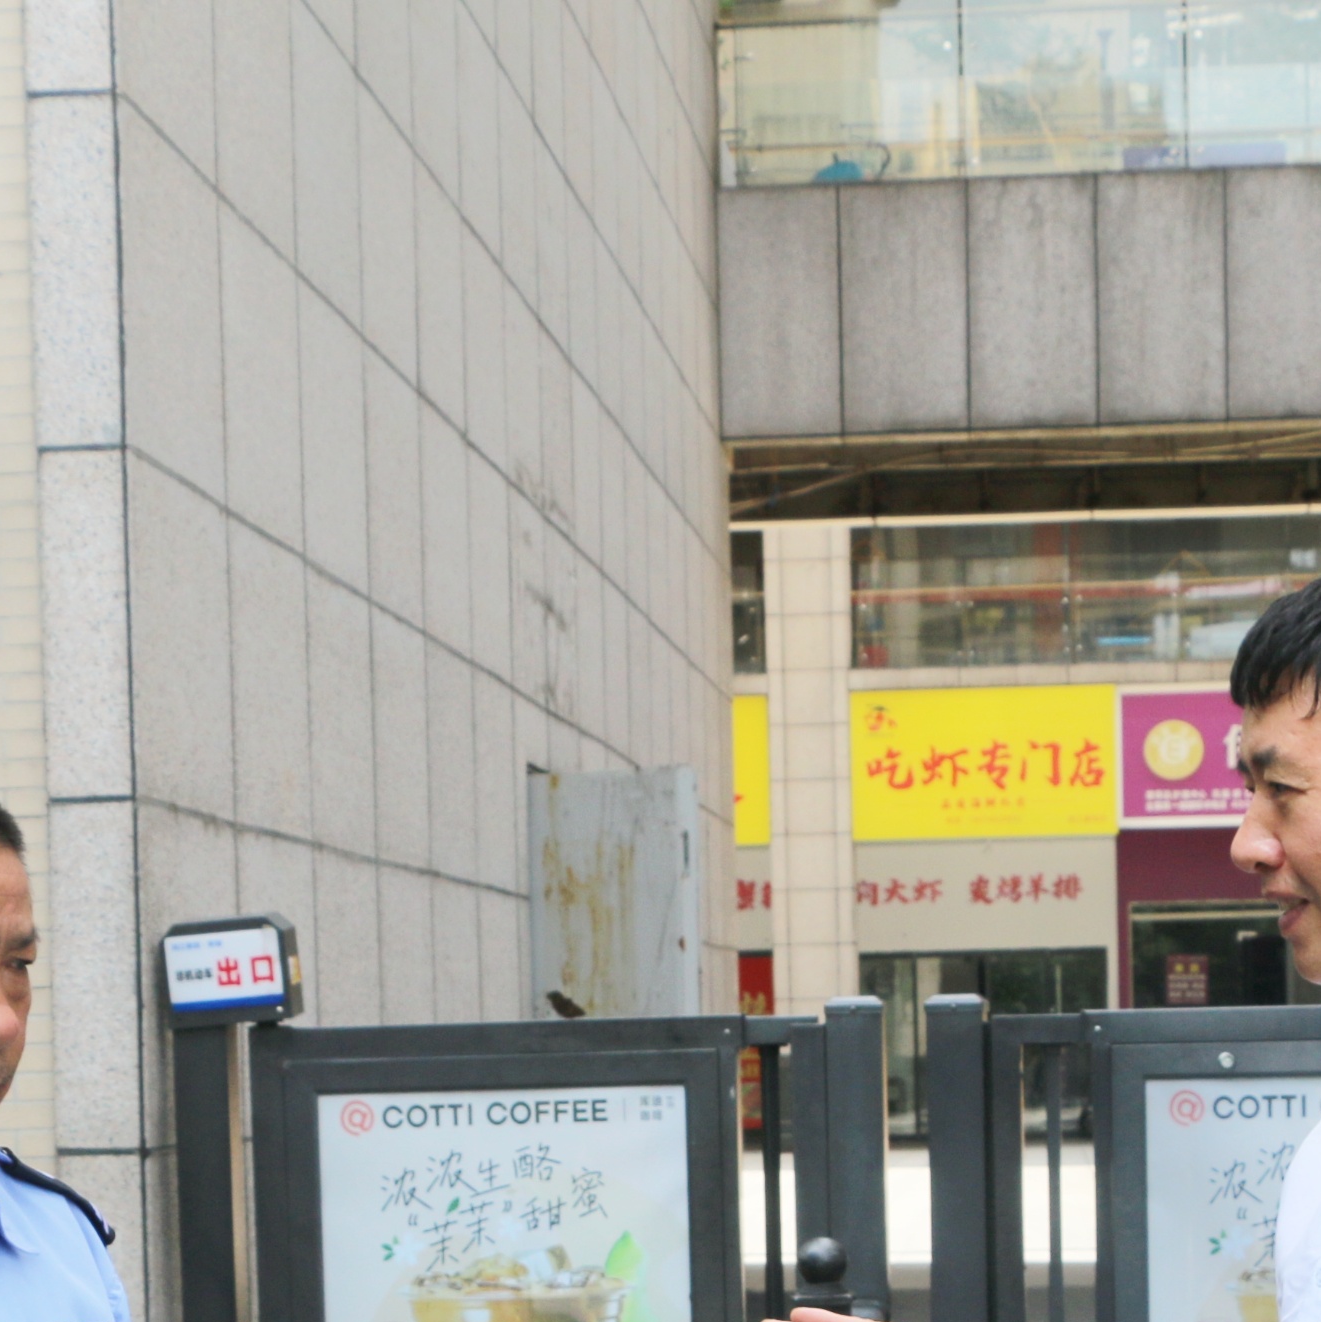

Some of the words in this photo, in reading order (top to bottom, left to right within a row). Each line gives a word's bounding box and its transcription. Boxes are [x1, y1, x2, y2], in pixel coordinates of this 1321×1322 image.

[866, 738, 1107, 791] 吃虾专门店
[217, 955, 275, 987] 出口
[382, 1103, 474, 1129] COTTI
[486, 1098, 609, 1126] COFFEE
[1213, 1094, 1308, 1119] COTTI
[380, 1142, 562, 1212] 浓浓生酪
